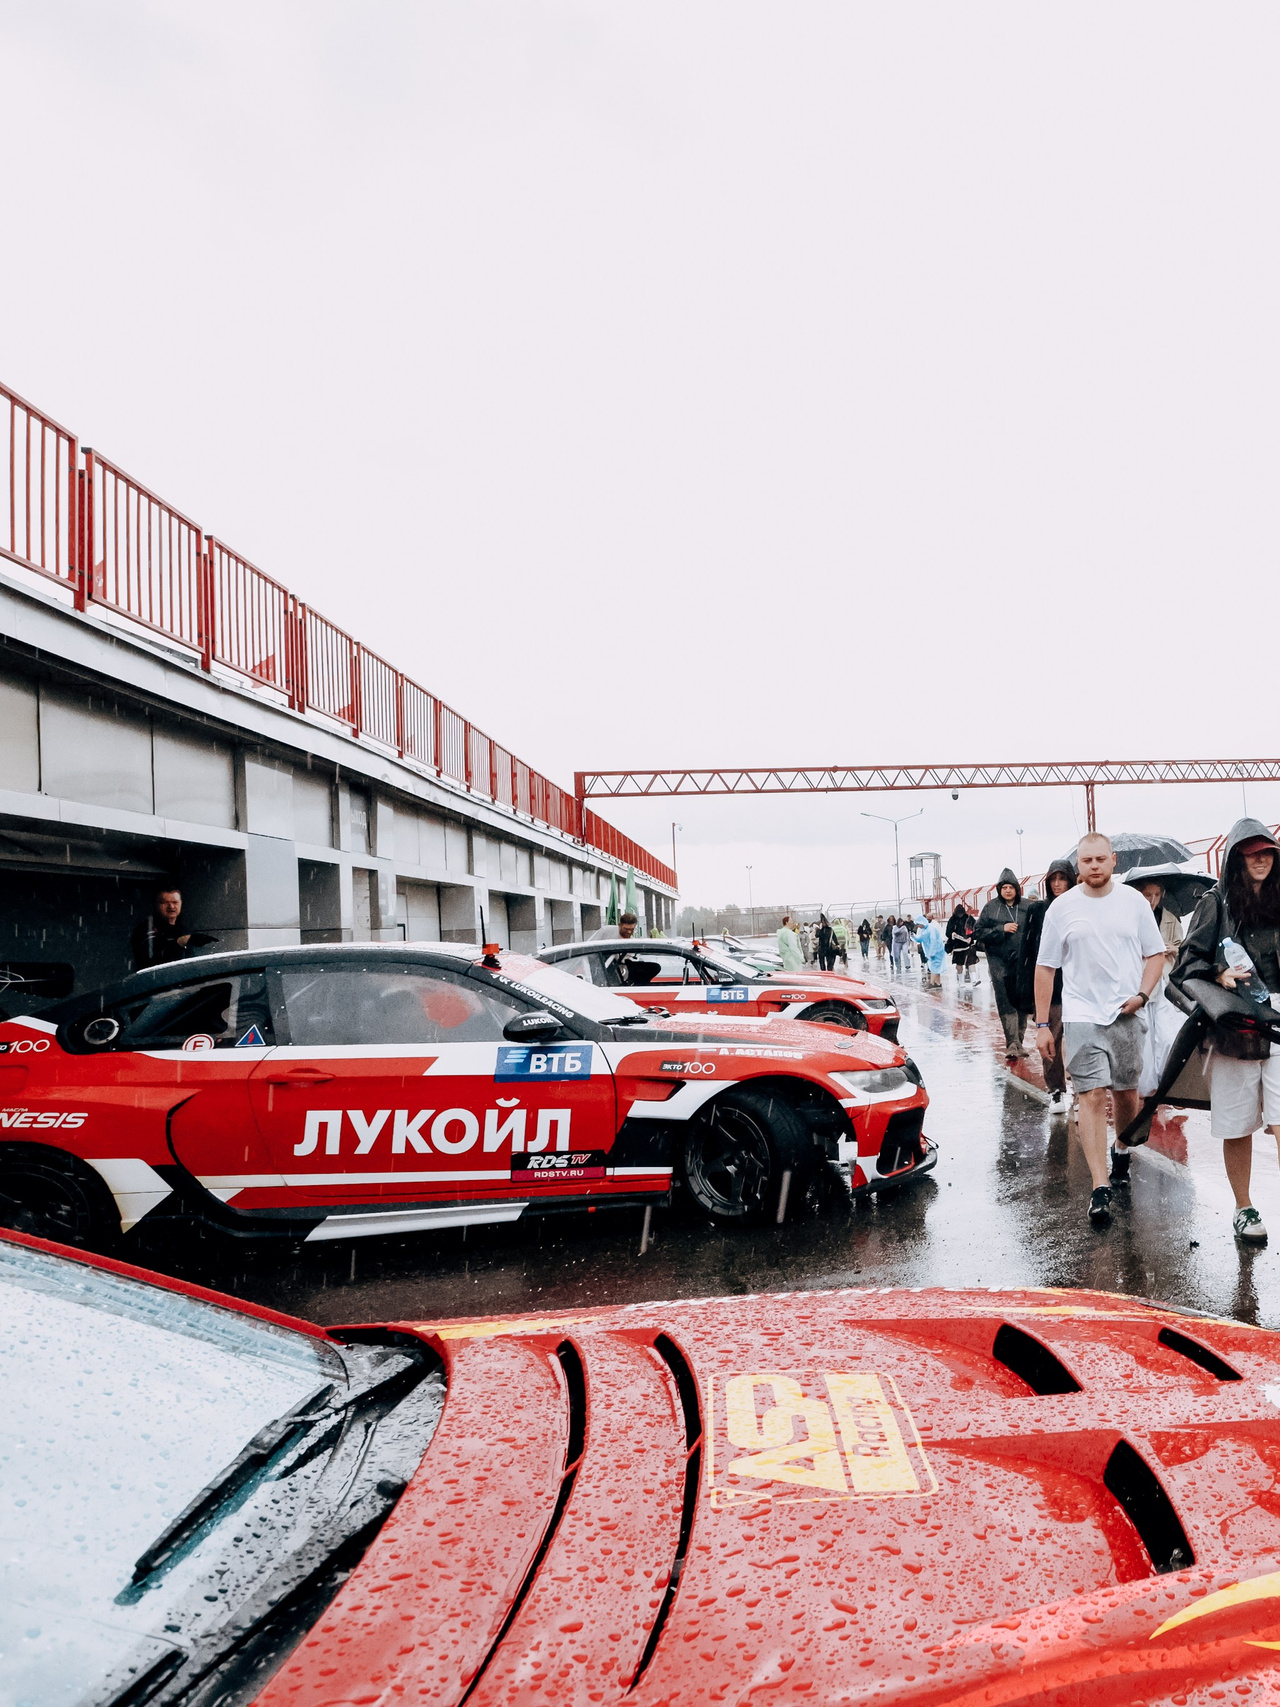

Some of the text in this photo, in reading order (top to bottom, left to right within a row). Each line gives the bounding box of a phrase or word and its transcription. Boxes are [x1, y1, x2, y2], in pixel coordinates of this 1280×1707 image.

[720, 990, 745, 1000] ВТБ
[522, 1017, 554, 1026] LUKOIL
[9, 1039, 51, 1054] 100
[530, 1052, 581, 1073] ВТБ
[683, 1061, 716, 1074] 100
[293, 1097, 572, 1156] ЛУКОЙЛ
[534, 1170, 584, 1178] RDSTV.RU
[845, 1396, 893, 1458] Racing
